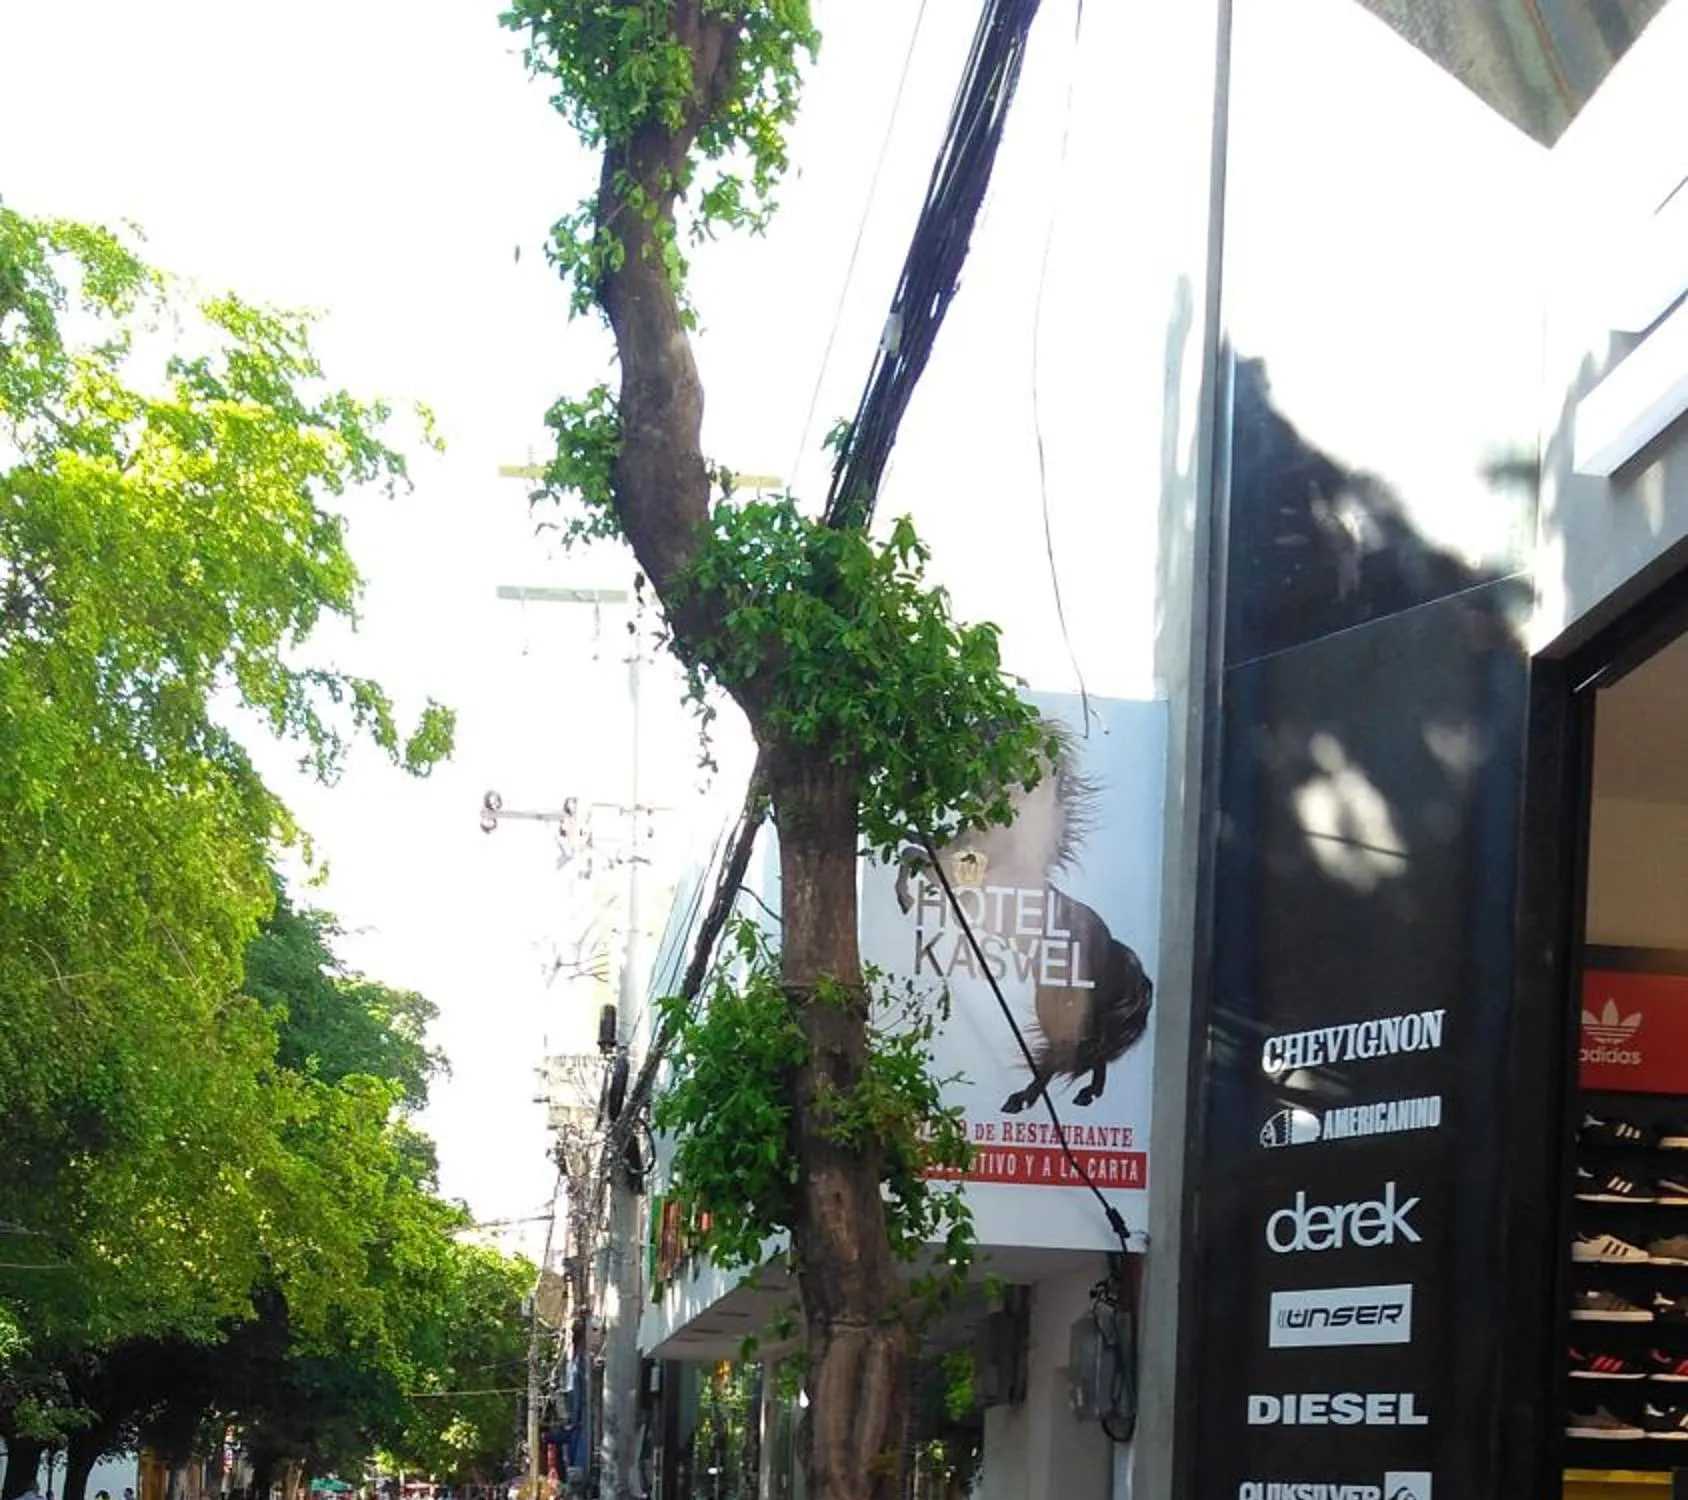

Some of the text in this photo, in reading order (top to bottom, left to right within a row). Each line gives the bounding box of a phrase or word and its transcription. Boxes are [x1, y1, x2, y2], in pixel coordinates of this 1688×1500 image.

[916, 879, 1071, 938] HOTEL
[1261, 1009, 1446, 1074] CHEVIGNON
[975, 1122, 996, 1141] DE
[1001, 1121, 1134, 1148] RESTAURANTE
[1323, 1096, 1442, 1141] AMERICANINO
[1025, 1155, 1034, 1177] Y
[1042, 1156, 1051, 1178] A
[1060, 1156, 1080, 1179] LA
[1087, 1158, 1139, 1181] CARTA
[1265, 1181, 1422, 1253] derek
[1247, 1393, 1428, 1426] DIESEL
